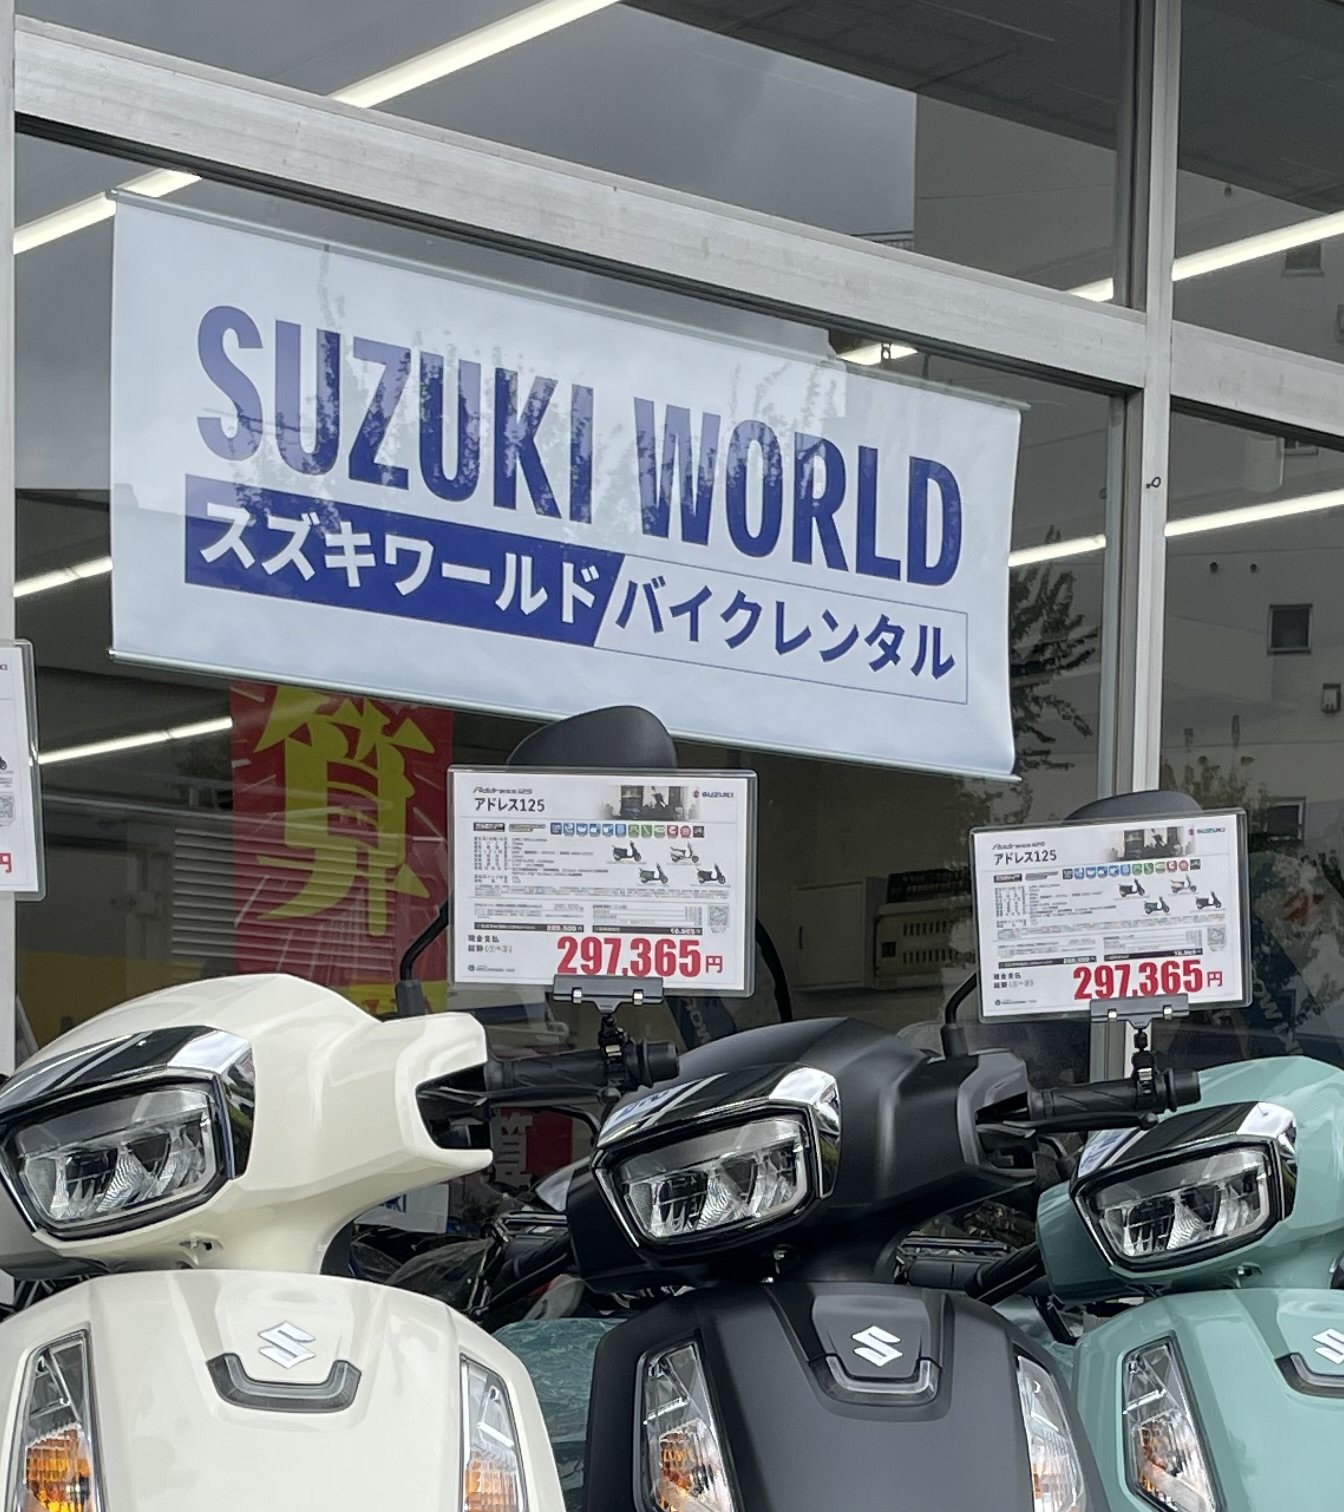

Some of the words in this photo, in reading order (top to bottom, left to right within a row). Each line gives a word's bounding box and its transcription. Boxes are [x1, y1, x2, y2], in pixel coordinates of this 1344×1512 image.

[197, 303, 595, 526] SUZUKI
[632, 395, 963, 588] WORLD
[199, 501, 601, 625] スズキワールド
[615, 575, 957, 682] バイクレンタル
[474, 796, 545, 813] アドレス125
[993, 848, 1057, 866] アドレス125
